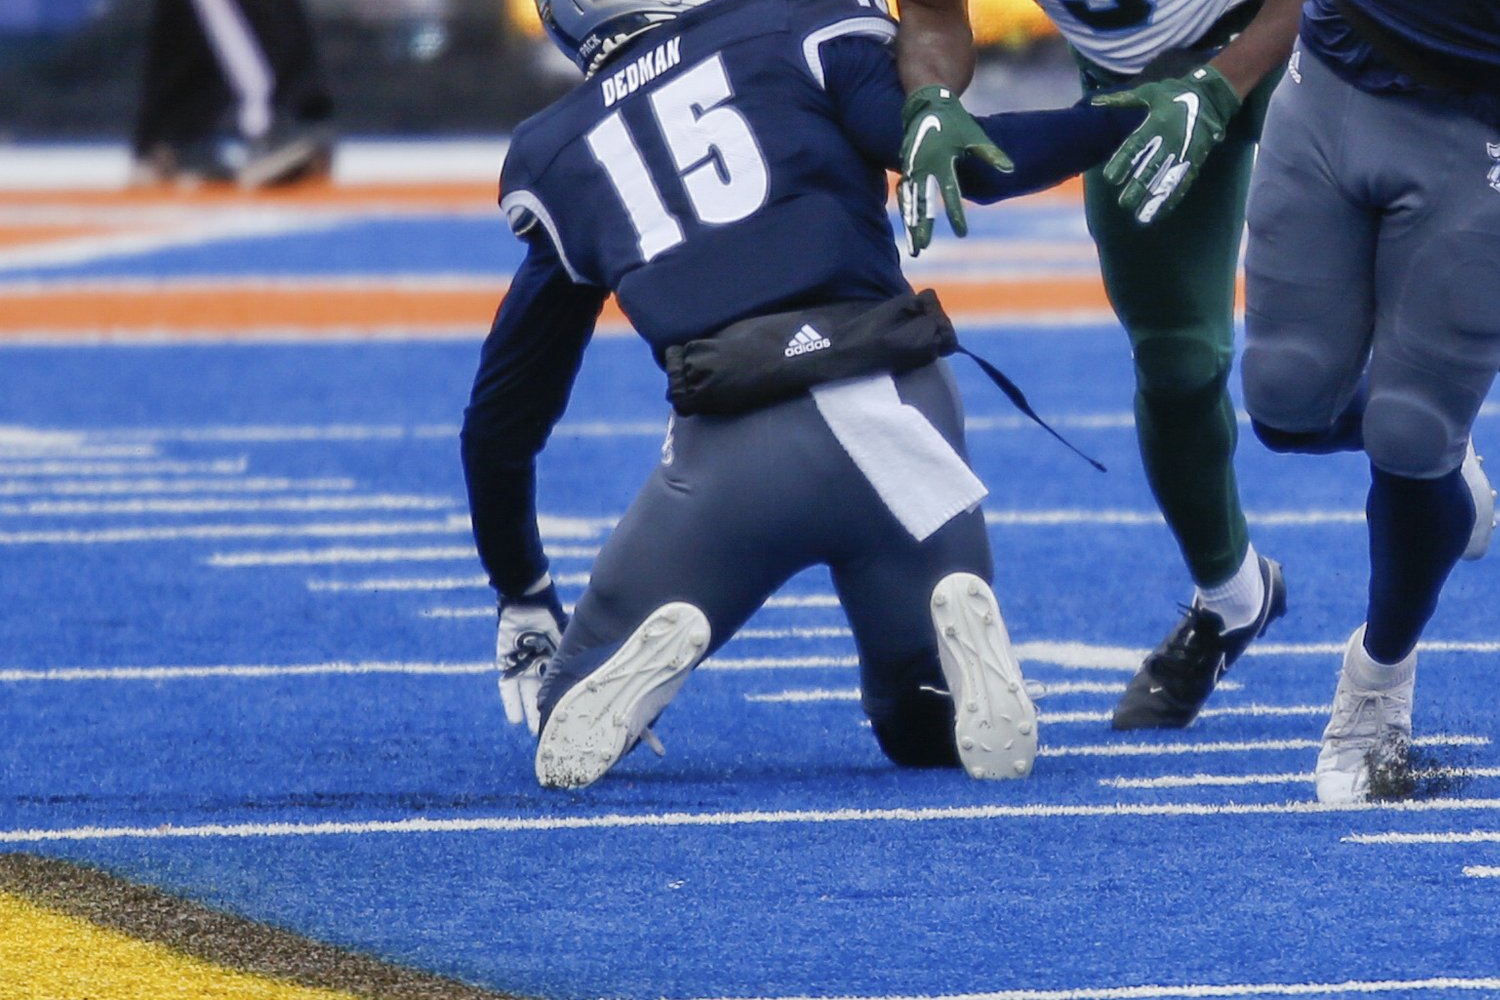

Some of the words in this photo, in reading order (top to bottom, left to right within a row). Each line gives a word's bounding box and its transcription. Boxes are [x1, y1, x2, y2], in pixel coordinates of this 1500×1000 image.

[601, 35, 681, 108] DEDMAN
[585, 51, 771, 264] 15
[784, 337, 831, 358] adidas
